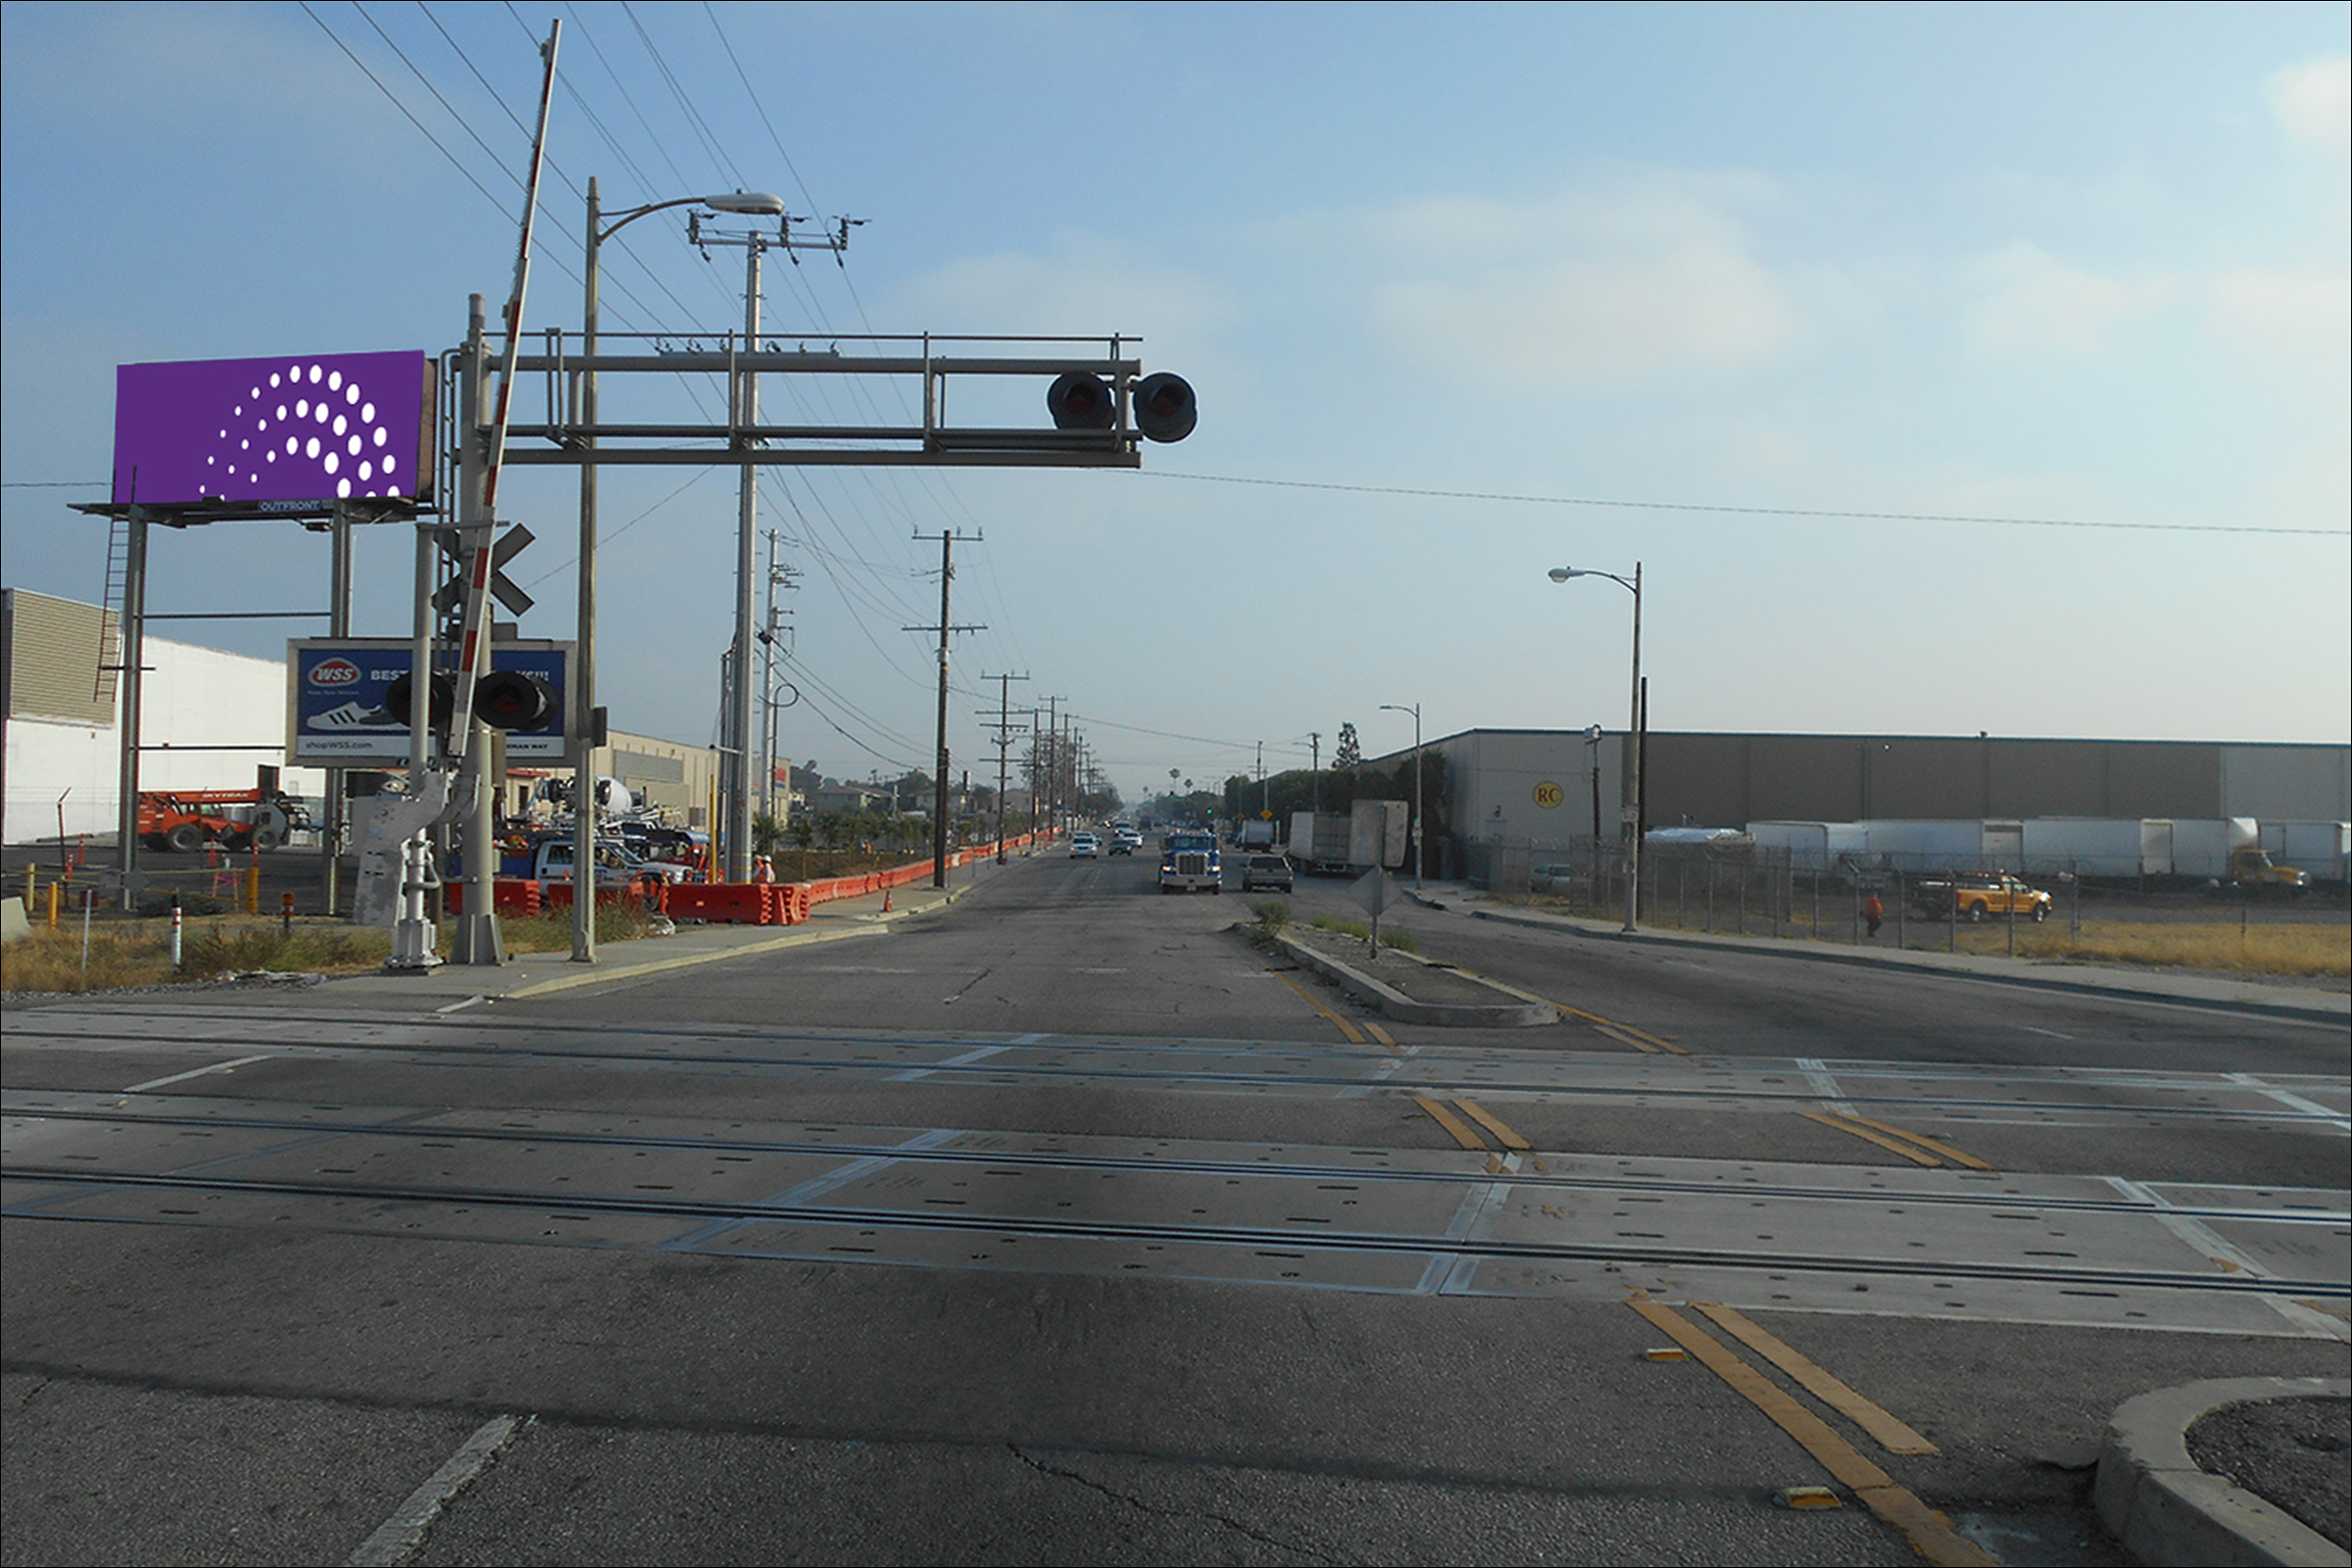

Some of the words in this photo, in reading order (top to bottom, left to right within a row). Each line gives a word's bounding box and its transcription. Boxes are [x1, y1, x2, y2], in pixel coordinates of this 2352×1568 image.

[259, 500, 320, 512] OUTFRONT
[317, 667, 354, 681] WSS
[1538, 787, 1560, 803] RC
